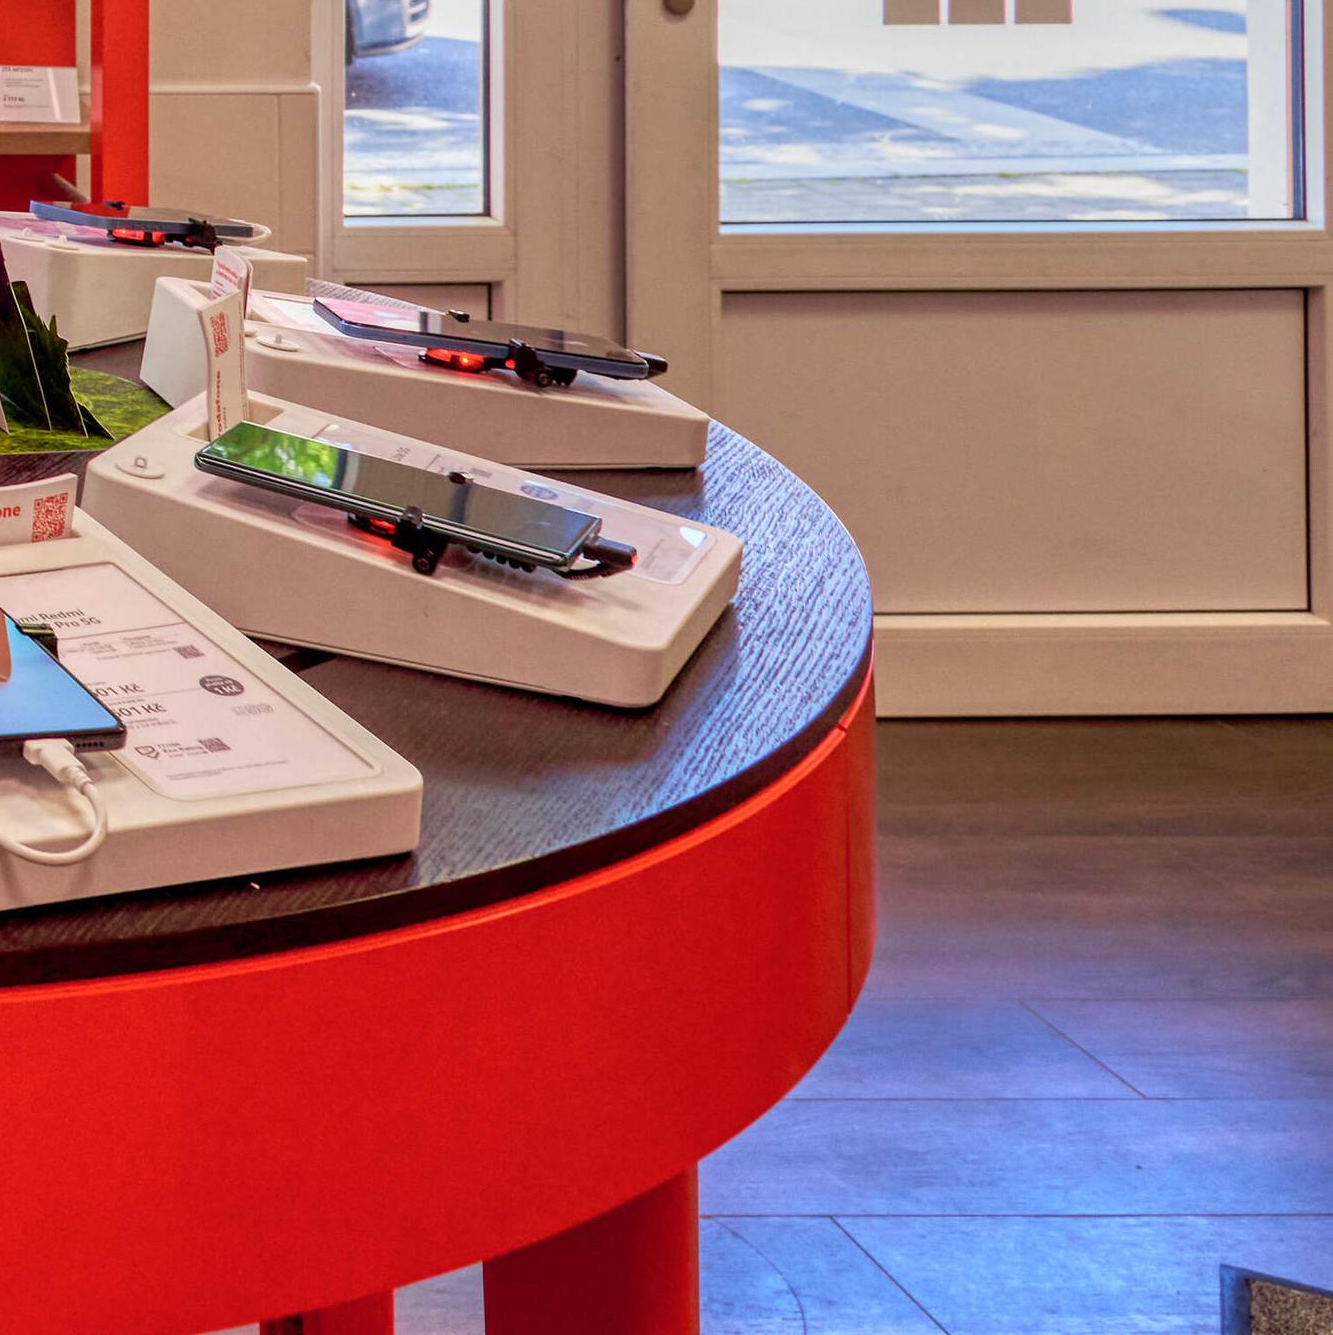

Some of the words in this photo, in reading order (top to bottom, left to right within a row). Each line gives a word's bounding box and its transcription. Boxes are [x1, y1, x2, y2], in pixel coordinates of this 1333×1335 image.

[40, 608, 85, 622] Redmi
[55, 620, 80, 631] Pro
[81, 617, 102, 627] 5G
